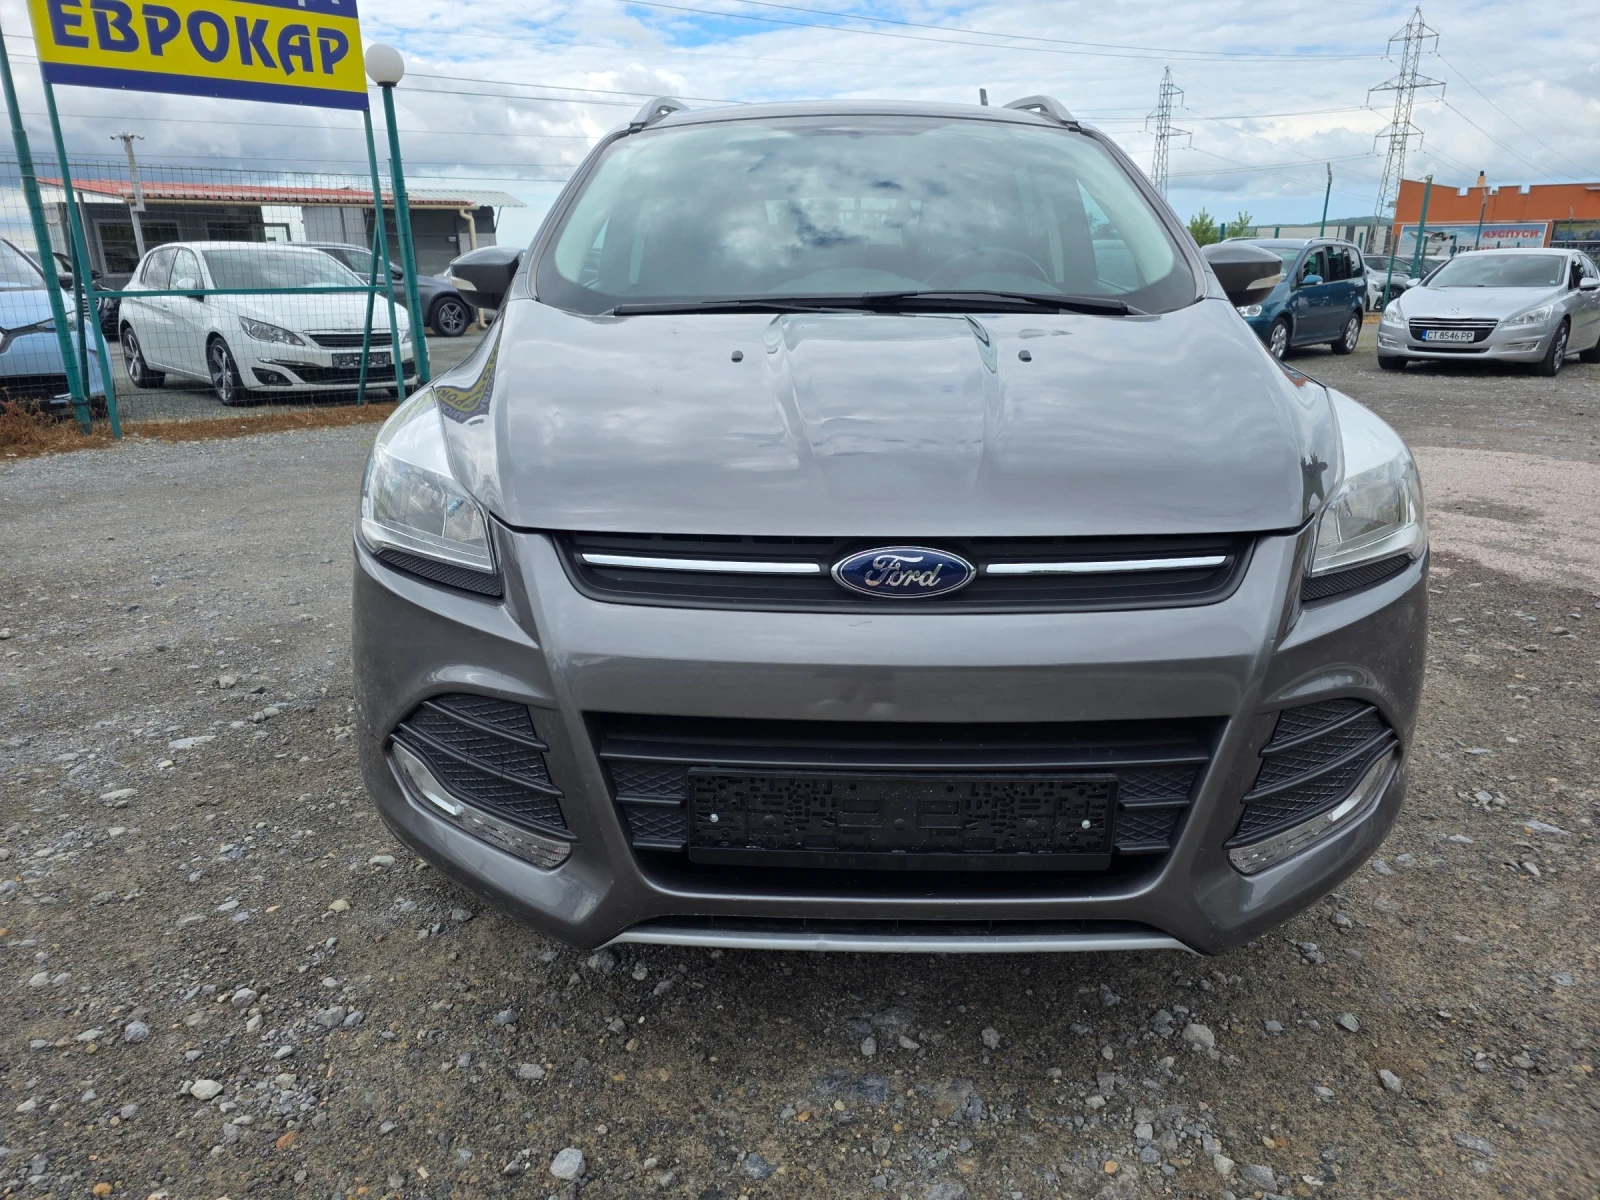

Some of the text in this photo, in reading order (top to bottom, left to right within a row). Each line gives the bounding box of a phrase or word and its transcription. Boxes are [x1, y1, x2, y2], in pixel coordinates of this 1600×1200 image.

[47, 0, 349, 76] ЕВРОКАР
[1482, 229, 1539, 239] АУСПУСИ
[1427, 331, 1473, 340] CT 8546 PP
[864, 554, 943, 587] Ford
